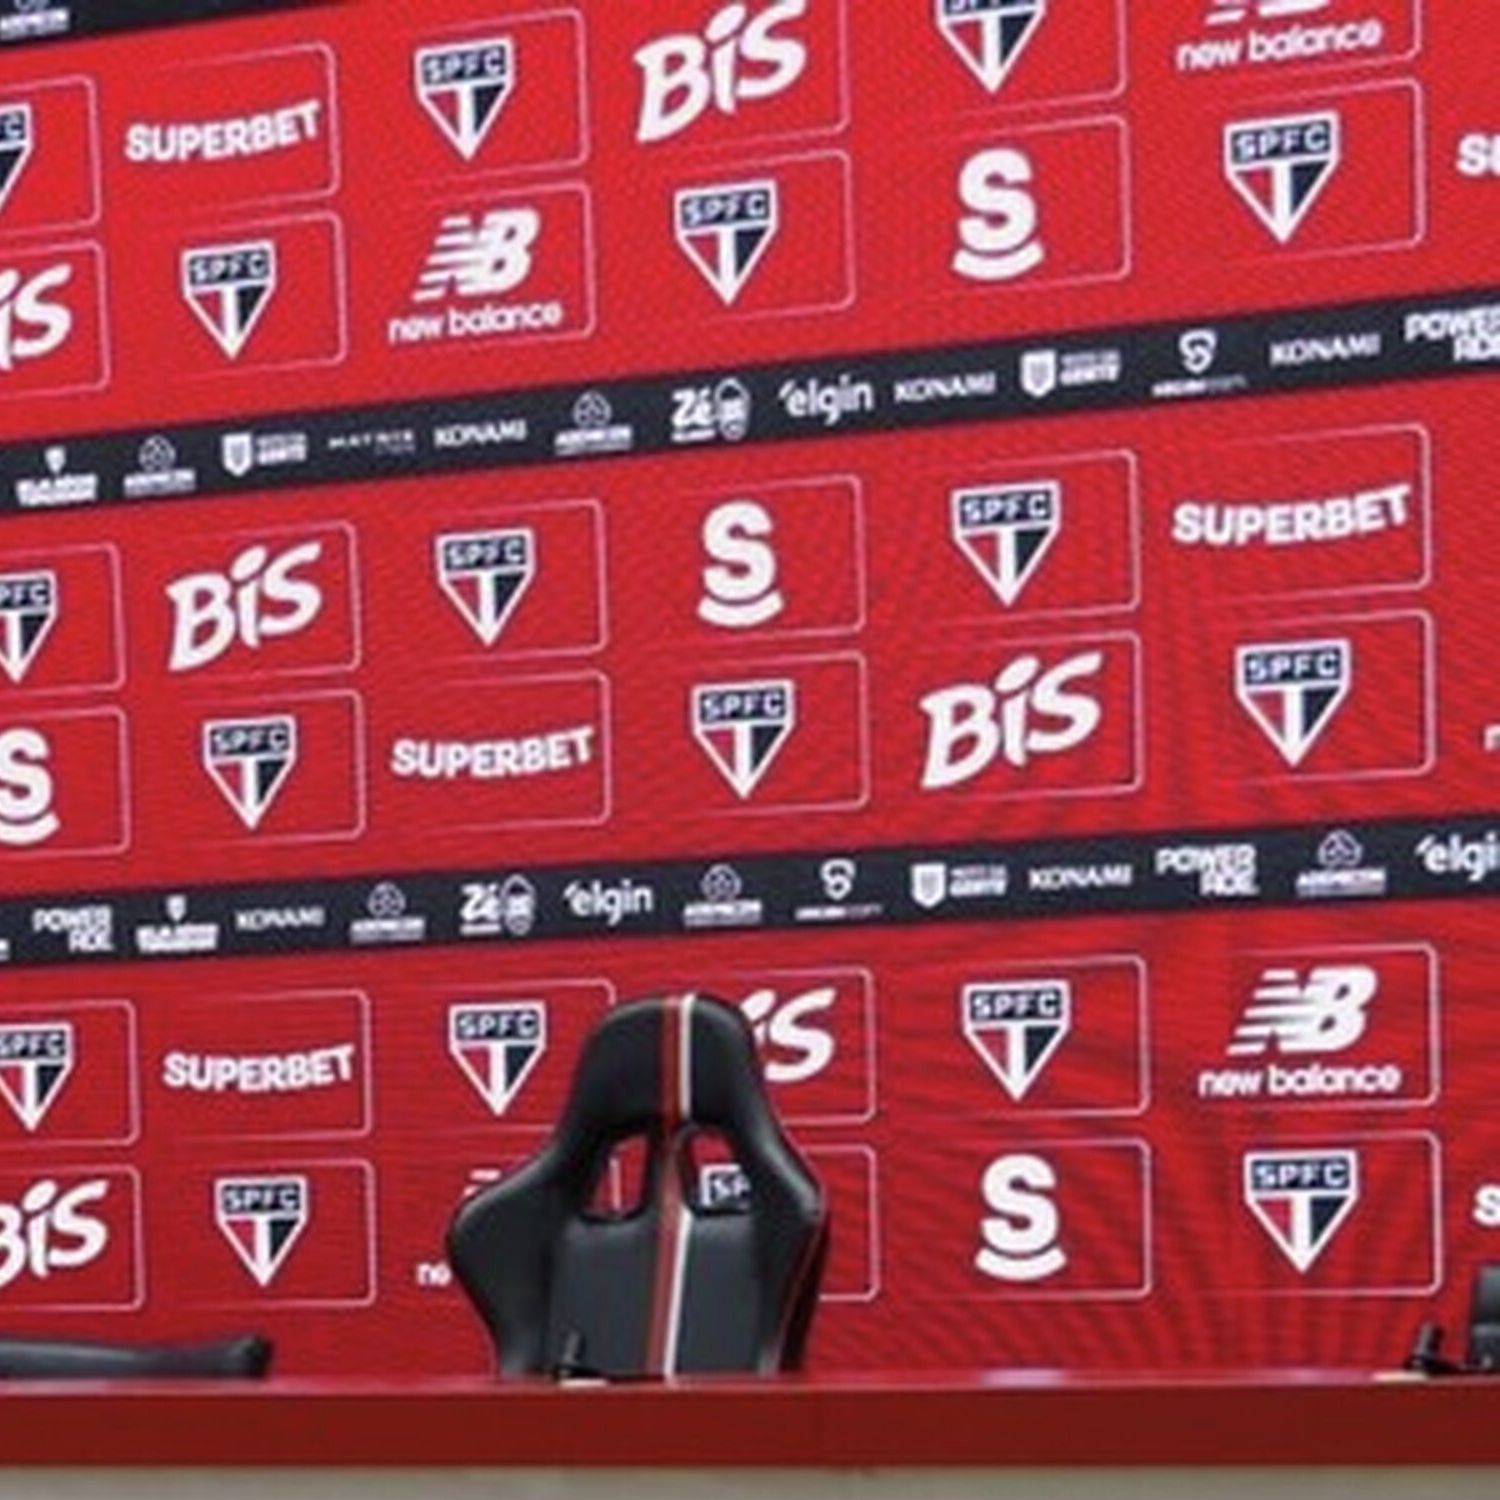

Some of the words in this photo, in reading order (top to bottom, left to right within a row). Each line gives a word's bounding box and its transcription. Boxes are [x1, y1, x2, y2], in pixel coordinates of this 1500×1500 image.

[1177, 42, 1239, 70] new
[1249, 20, 1381, 64] balance
[425, 50, 505, 80] SPFC
[125, 100, 322, 162] SUPERBET
[1234, 126, 1331, 158] SPFC
[682, 192, 768, 222] SPFC
[189, 253, 266, 281] SPFC
[389, 312, 444, 345] new
[449, 301, 564, 336] balance
[1270, 333, 1382, 367] KONAMI
[895, 370, 997, 402] KONAMI
[434, 419, 527, 448] KONAMI
[959, 492, 1051, 522] SPFC
[1172, 484, 1411, 545] SUPERBET
[445, 539, 525, 568] SPFC
[1245, 651, 1344, 682] SPFC
[701, 691, 786, 720] SPFC
[210, 728, 289, 752] SPFC
[391, 726, 595, 779] SUPERBET
[1156, 845, 1257, 874] POWER
[1030, 865, 1133, 890] KONAMI
[32, 905, 112, 932] POWER
[235, 908, 324, 932] KONAMI
[972, 991, 1062, 1019] SPFC
[458, 1014, 538, 1040] SPFC
[162, 1044, 355, 1092] SUPERBET
[1198, 1070, 1262, 1097] new
[1266, 1066, 1400, 1094] balance
[1253, 1159, 1347, 1189] SPFC
[222, 1185, 300, 1212] SPFC
